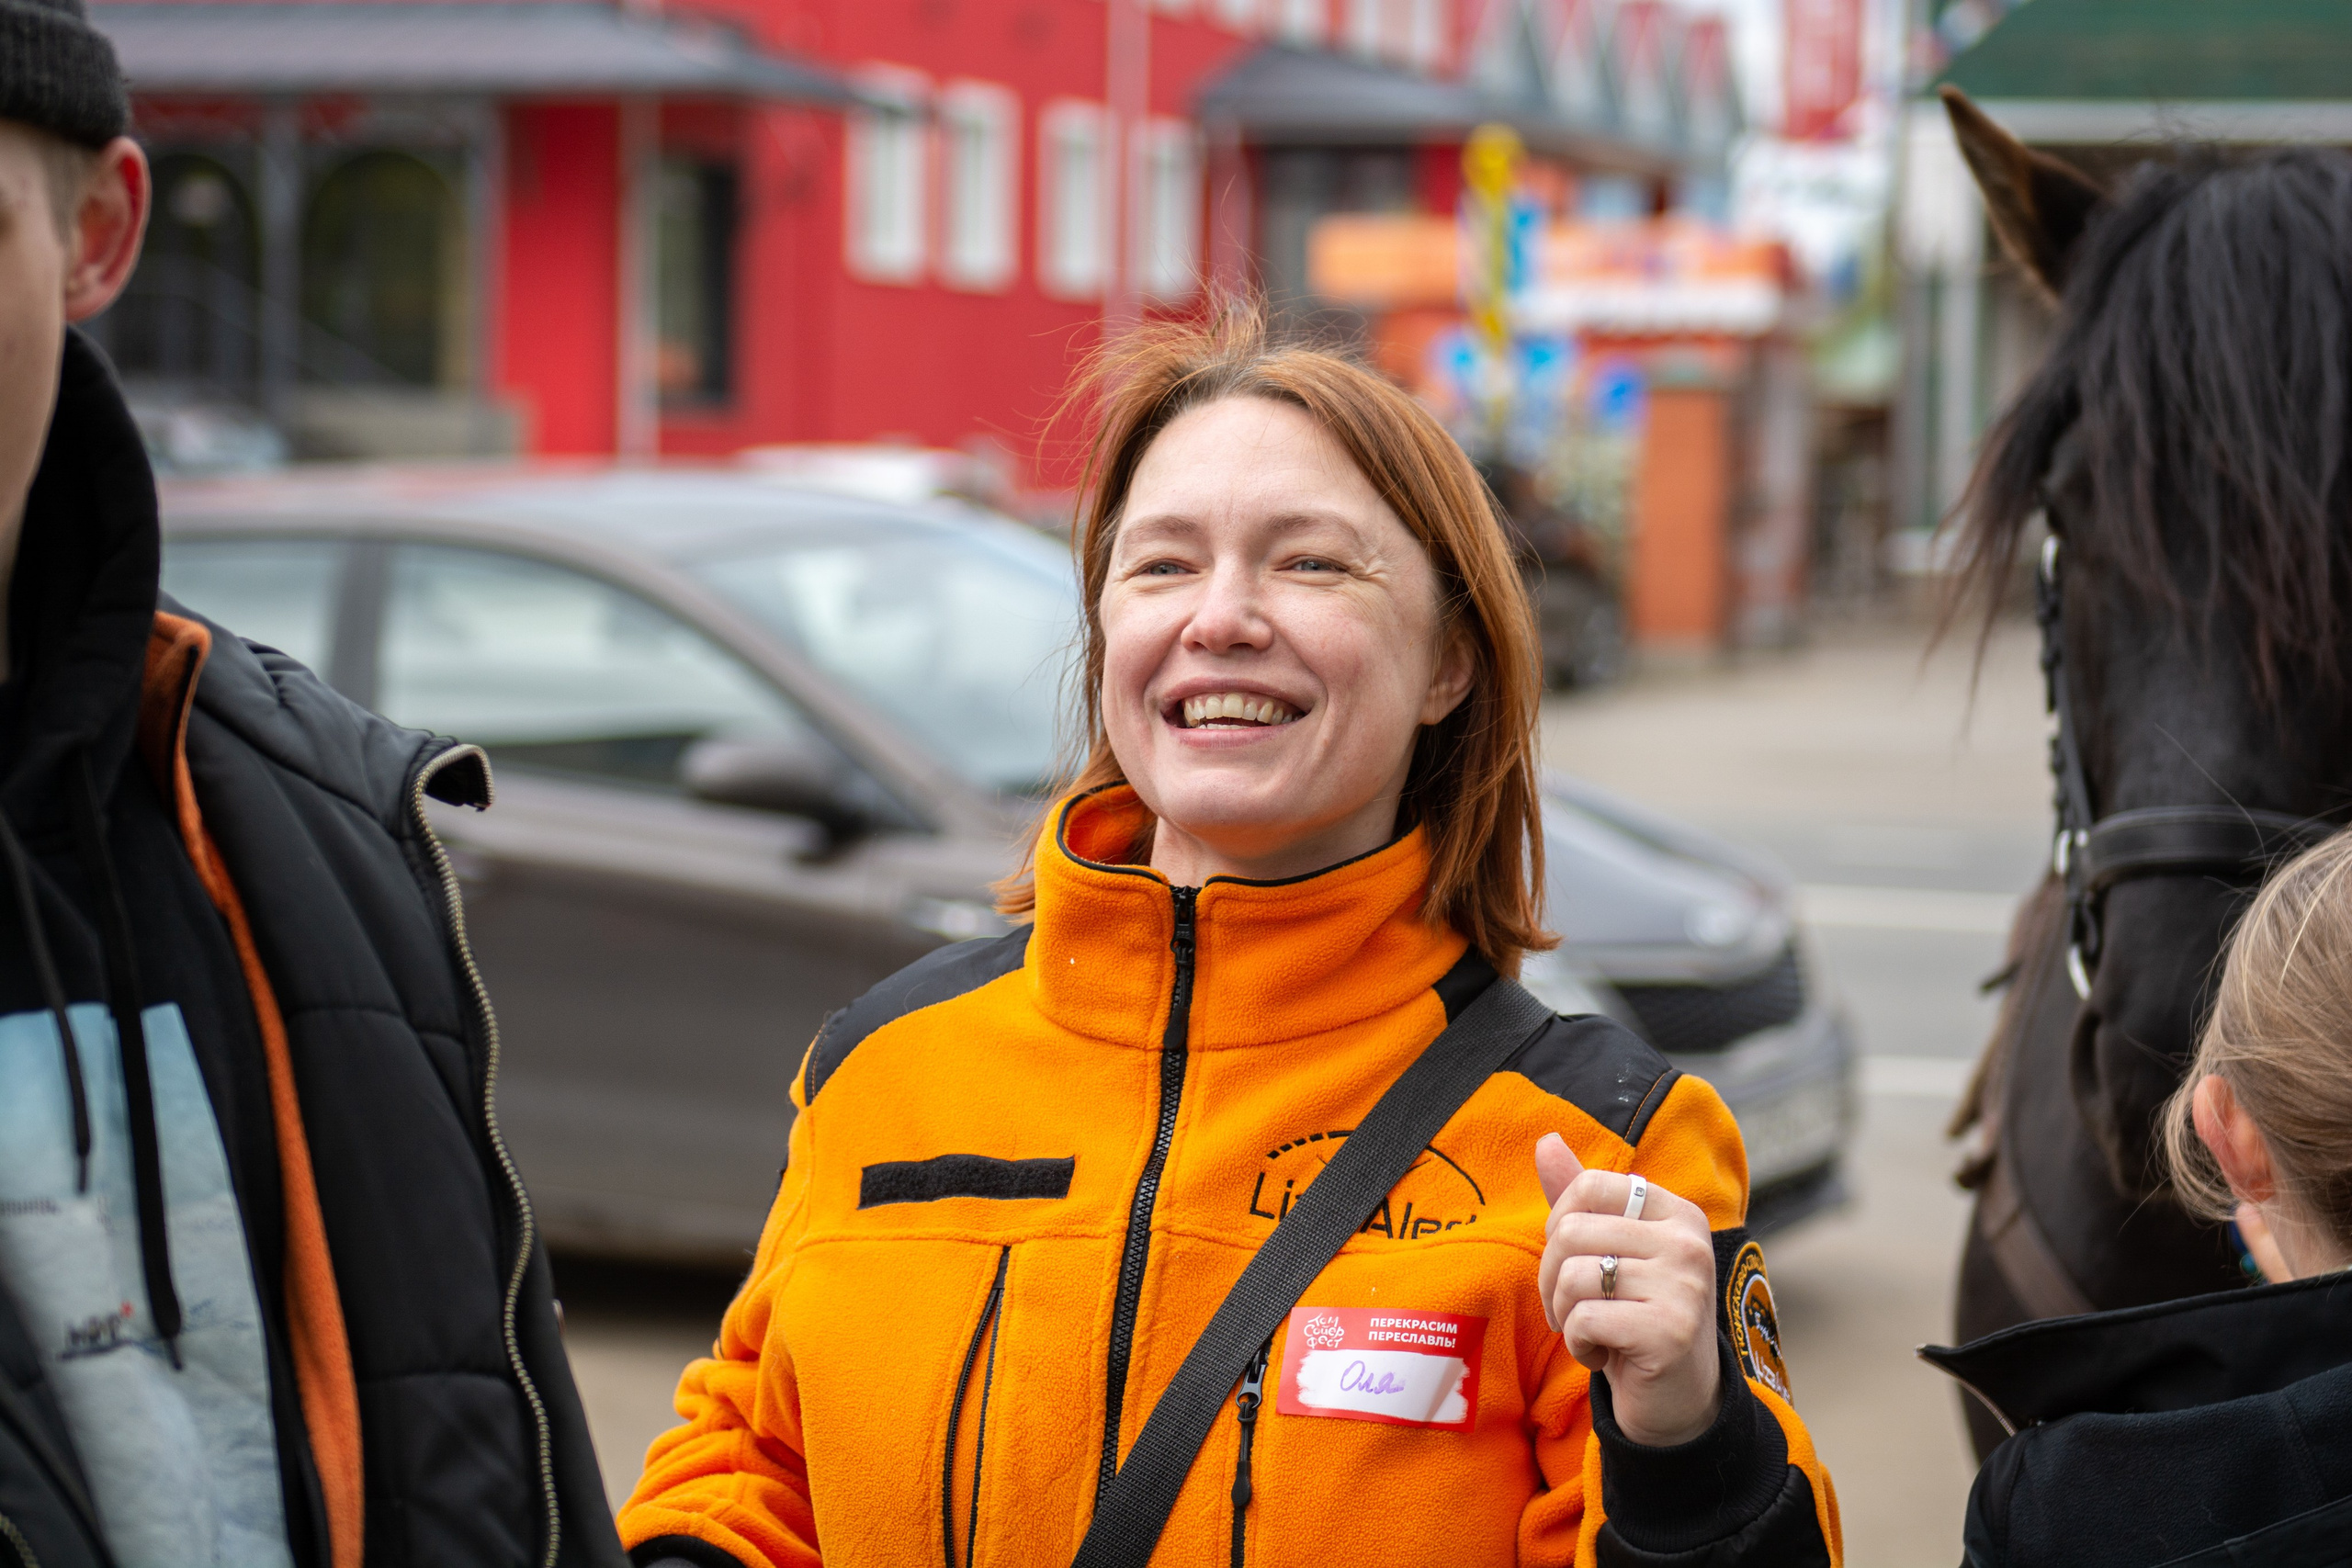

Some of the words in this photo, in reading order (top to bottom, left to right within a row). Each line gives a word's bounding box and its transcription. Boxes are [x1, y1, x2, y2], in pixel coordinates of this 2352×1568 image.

[1304, 1324, 1345, 1339] Сойер
[1370, 1317, 1458, 1335] ПЕРЕКРАСИМ
[1368, 1331, 1456, 1348] ПЕРЕСЛАВЛЬ!
